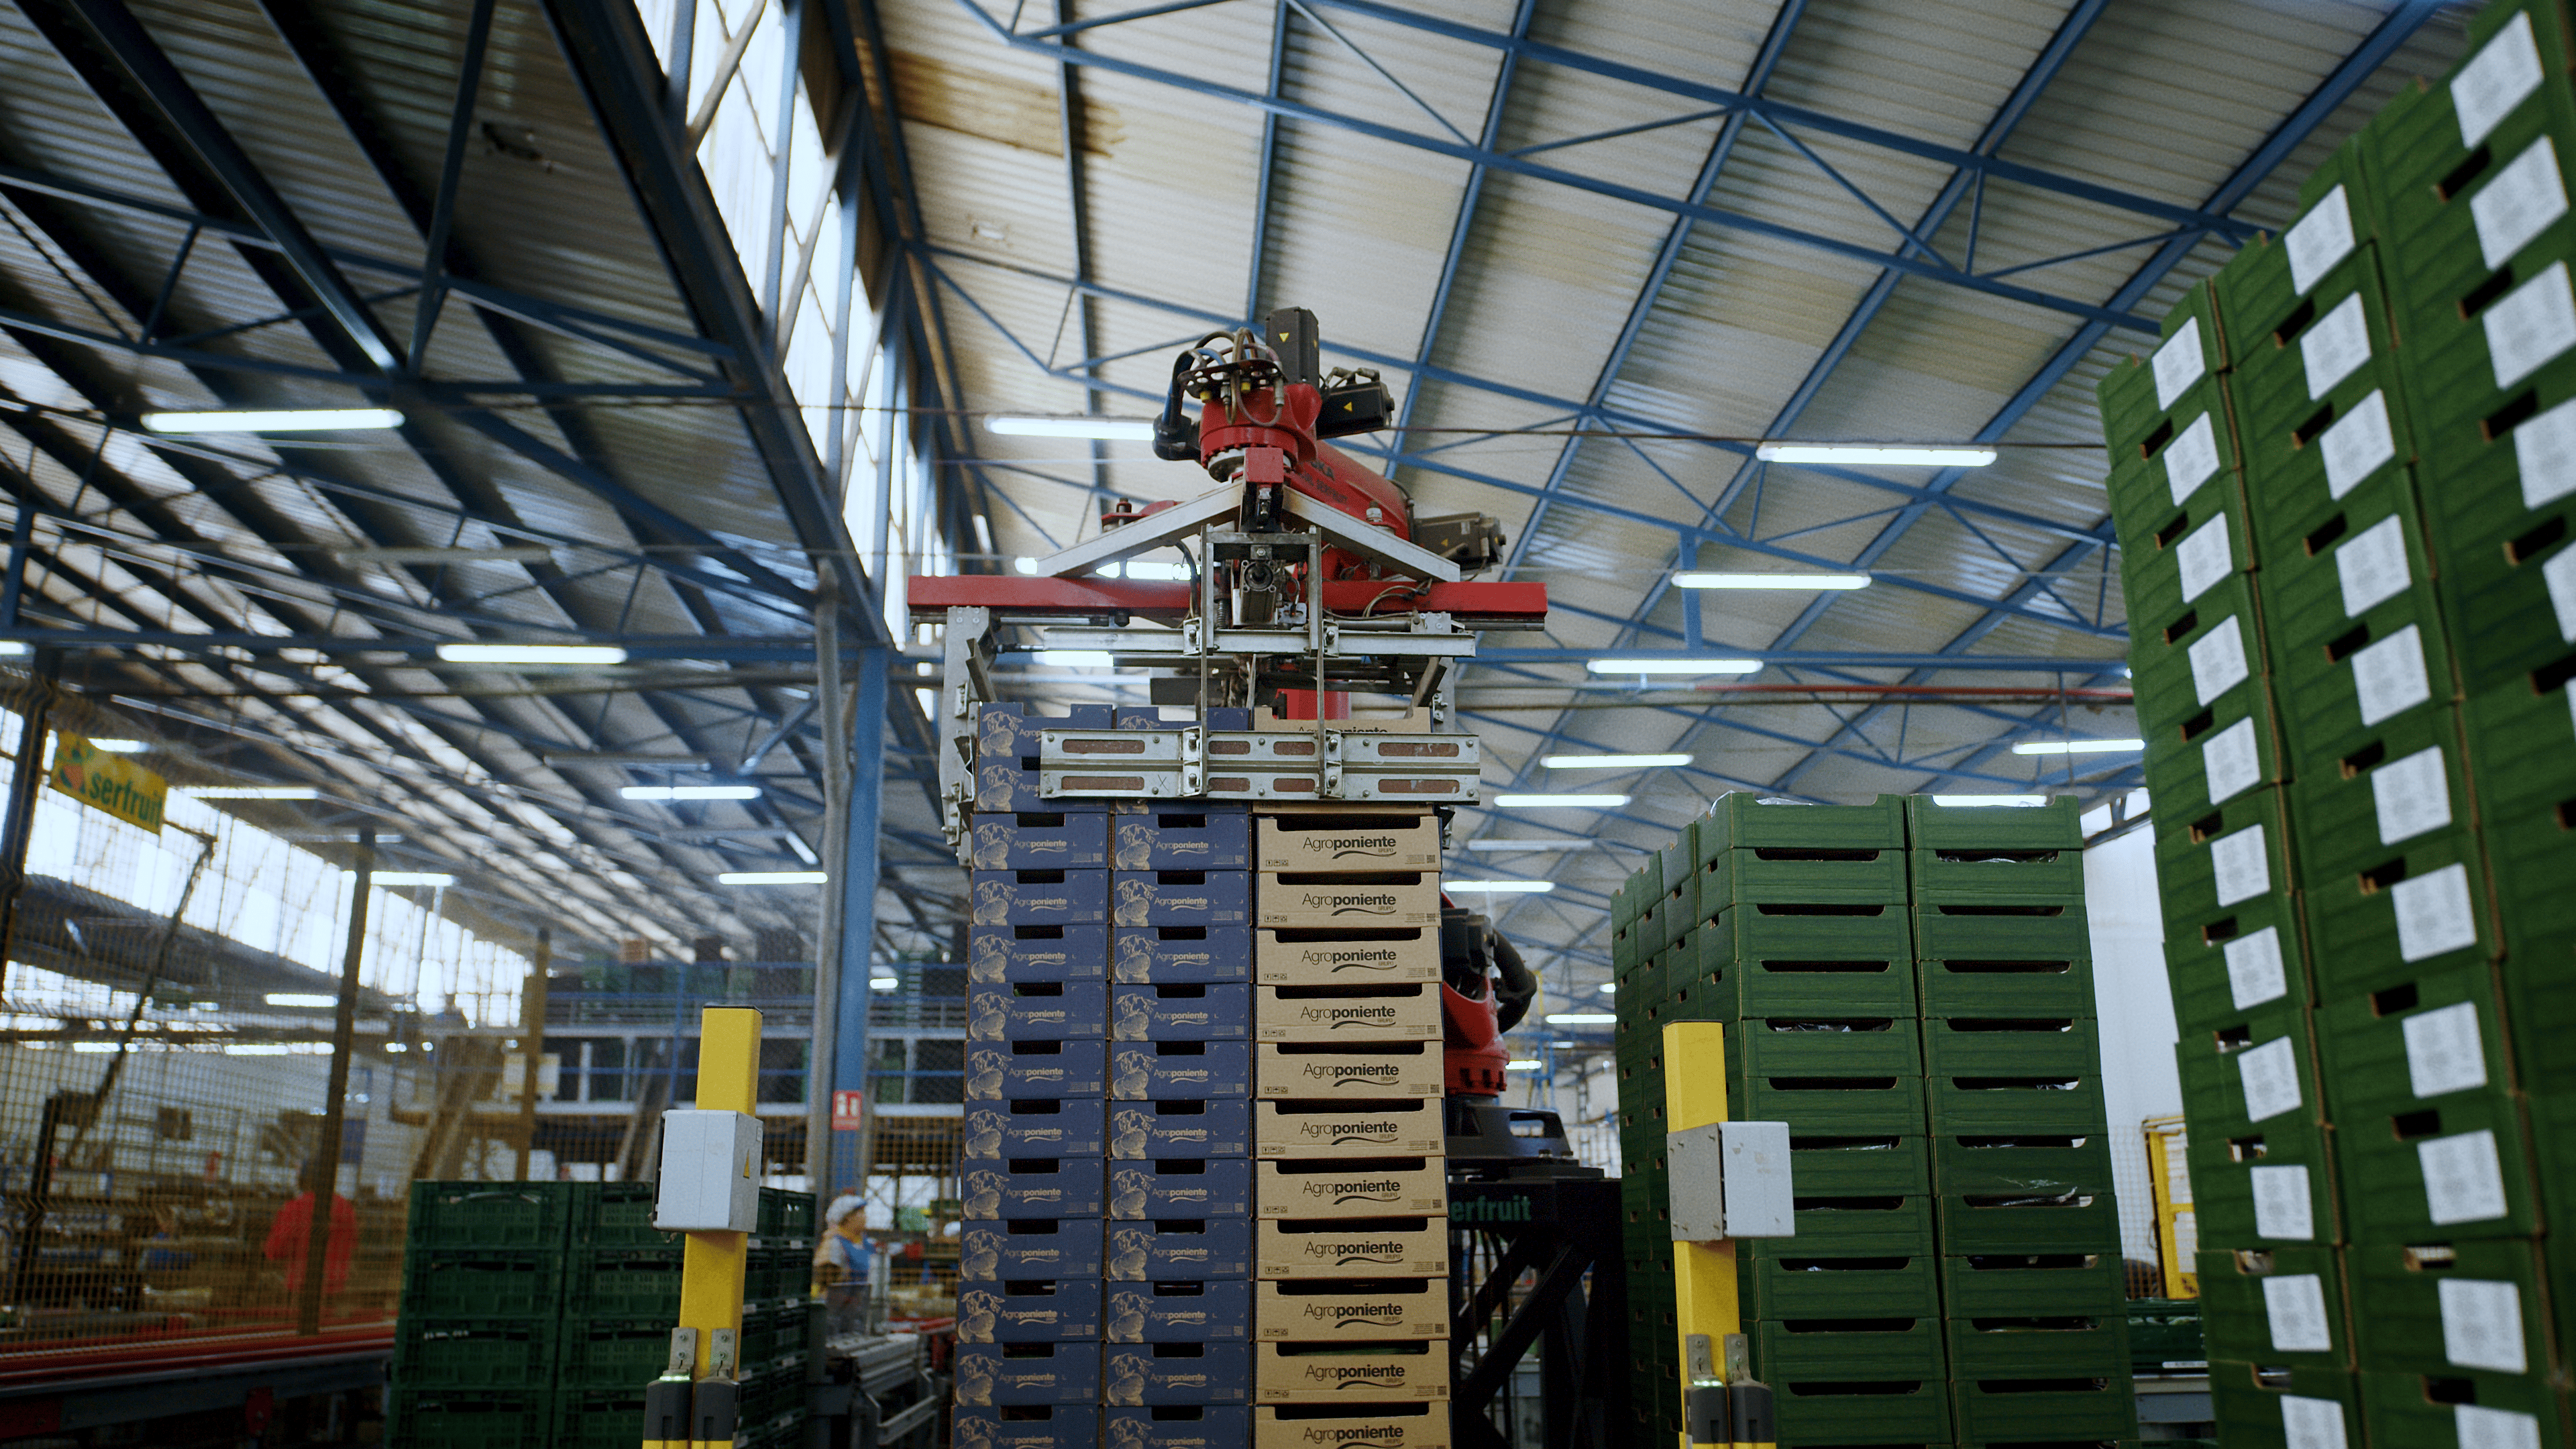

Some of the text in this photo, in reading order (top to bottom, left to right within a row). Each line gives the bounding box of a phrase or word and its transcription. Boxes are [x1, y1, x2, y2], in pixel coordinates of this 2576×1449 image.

[1014, 839, 1067, 849] Agroponiente
[1156, 841, 1208, 850] Agroponiente
[1303, 836, 1396, 851] Agroponiente
[1014, 898, 1067, 907] Agroponiente
[1154, 897, 1208, 906] Agroponiente
[1302, 893, 1396, 908] Agroponiente
[1012, 952, 1066, 961] Agroponiente
[1156, 952, 1210, 961] Agroponiente
[1301, 949, 1396, 965] Agroponiente
[1011, 1010, 1065, 1019] Agroponiente
[1154, 1011, 1208, 1021] Agroponiente
[1301, 1006, 1395, 1021] Agroponiente
[1008, 1067, 1063, 1077] Agroponiente
[1154, 1069, 1208, 1078] Agroponiente
[1303, 1063, 1399, 1079] Agroponiente
[1007, 1128, 1062, 1137] Agroponiente
[1152, 1128, 1207, 1138] Agroponiente
[1301, 1121, 1397, 1137] Agroponiente
[1152, 1188, 1208, 1197] Agroponiente
[1303, 1179, 1400, 1196] Agroponiente
[1006, 1188, 1061, 1198] Agroponiente
[1449, 1194, 1531, 1222] erfruit
[1152, 1248, 1208, 1257] Agroponiente
[1305, 1240, 1403, 1257] Agroponiente
[1001, 1310, 1058, 1320] Agroponiente
[1150, 1311, 1206, 1320] Agroponiente
[1304, 1303, 1402, 1320] Agroponiente
[1305, 1364, 1405, 1381] Agroponiente
[1303, 1425, 1403, 1443] Agroponiente
